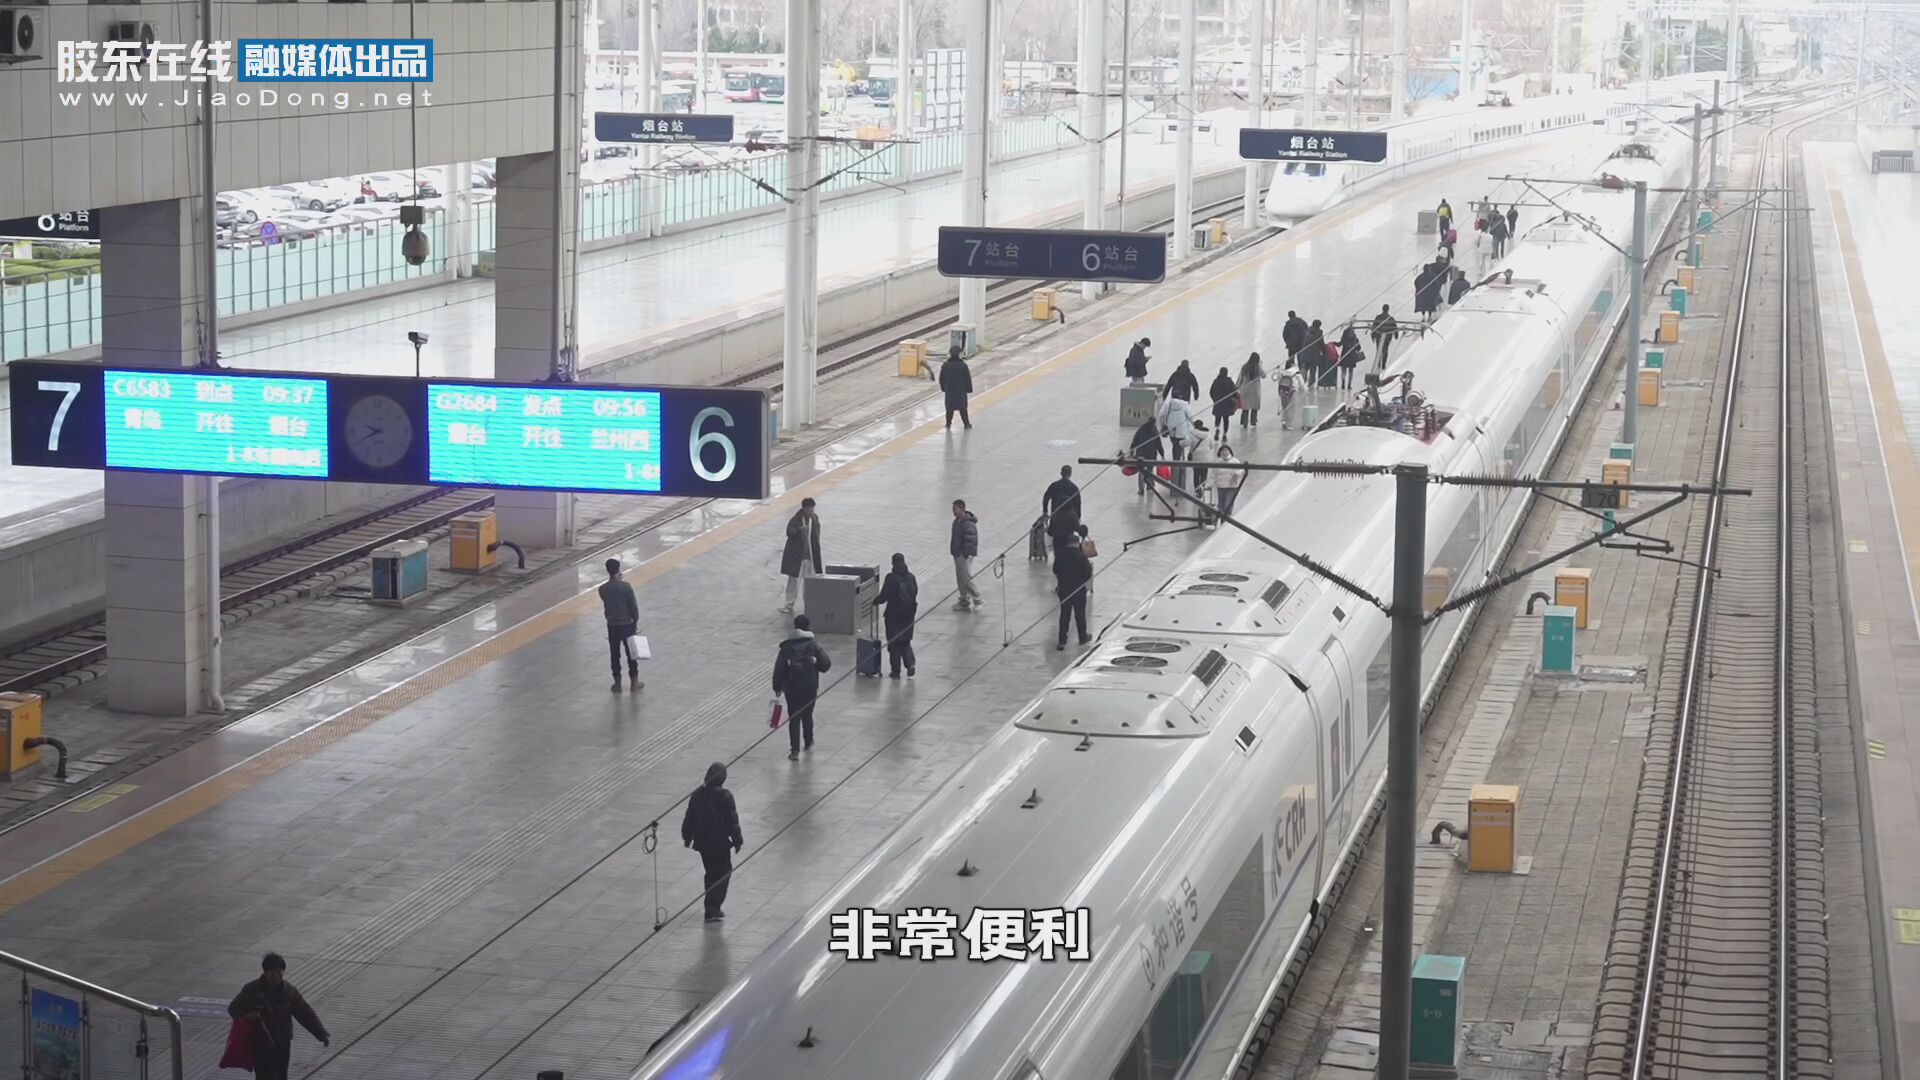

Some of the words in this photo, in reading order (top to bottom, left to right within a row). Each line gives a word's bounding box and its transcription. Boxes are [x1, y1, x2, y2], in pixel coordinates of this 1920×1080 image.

[642, 119, 684, 132] 烟台站
[1290, 136, 1335, 150] 烟台站
[59, 223, 89, 231] Platform
[964, 239, 982, 267] 7
[985, 241, 1020, 258] 站台
[1082, 243, 1100, 272] 6
[1104, 245, 1138, 261] 站台
[38, 381, 81, 451] 7
[593, 398, 646, 417] 09:56
[689, 406, 737, 482] 6
[1286, 786, 1306, 861] CRH
[1152, 875, 1198, 970] 和谐号
